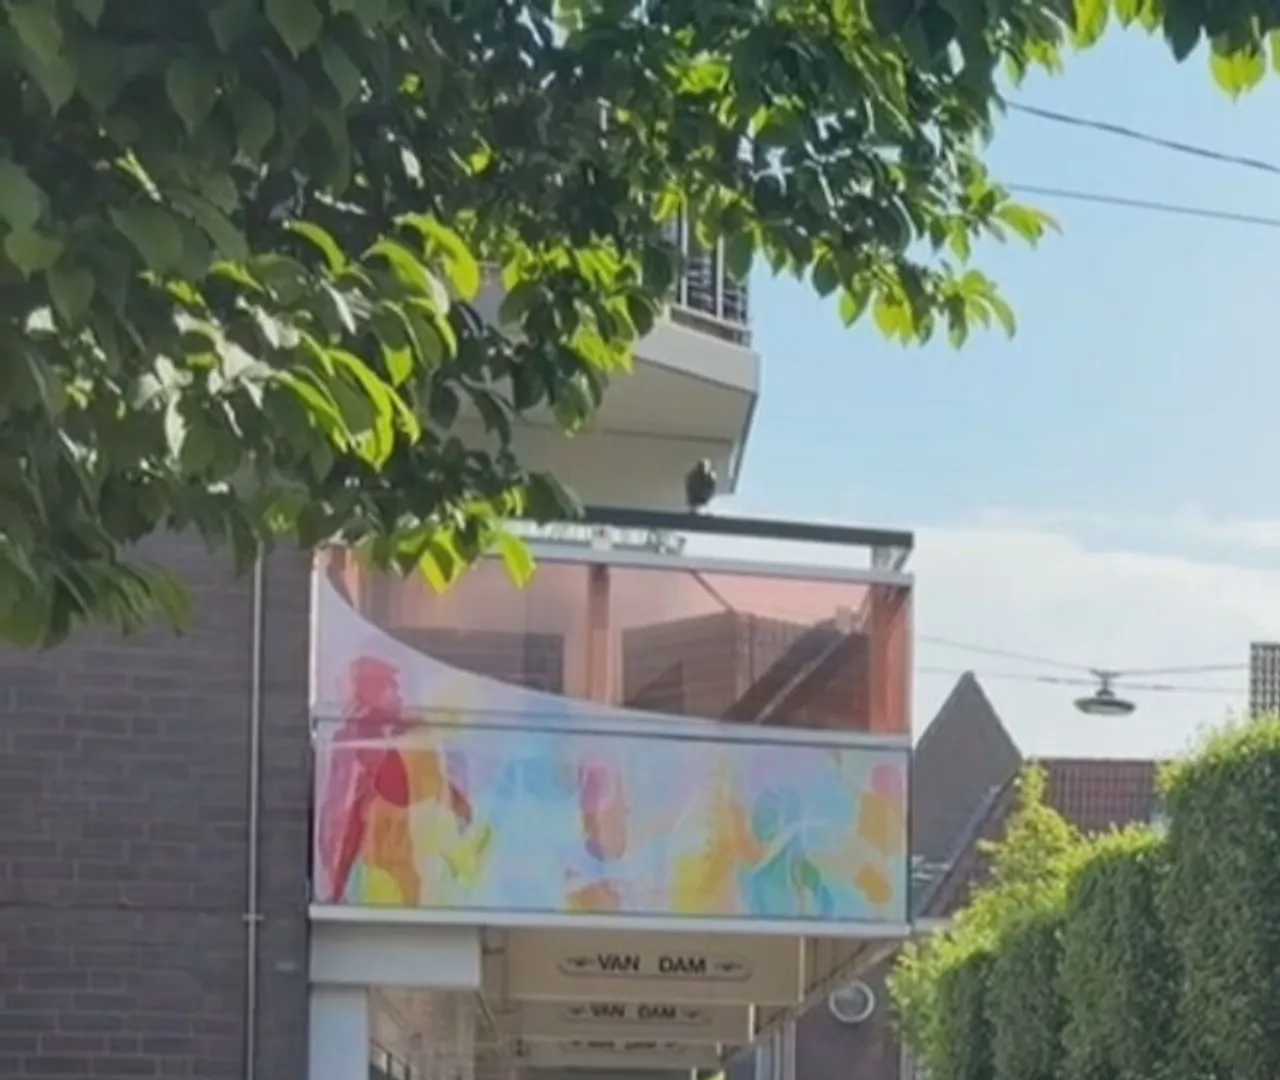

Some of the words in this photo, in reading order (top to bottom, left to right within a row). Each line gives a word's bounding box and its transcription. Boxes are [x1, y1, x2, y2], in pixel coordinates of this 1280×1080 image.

[597, 953, 640, 971] VAN
[658, 956, 707, 973] DAM
[590, 1003, 625, 1018] VAN
[638, 1004, 676, 1019] DAM
